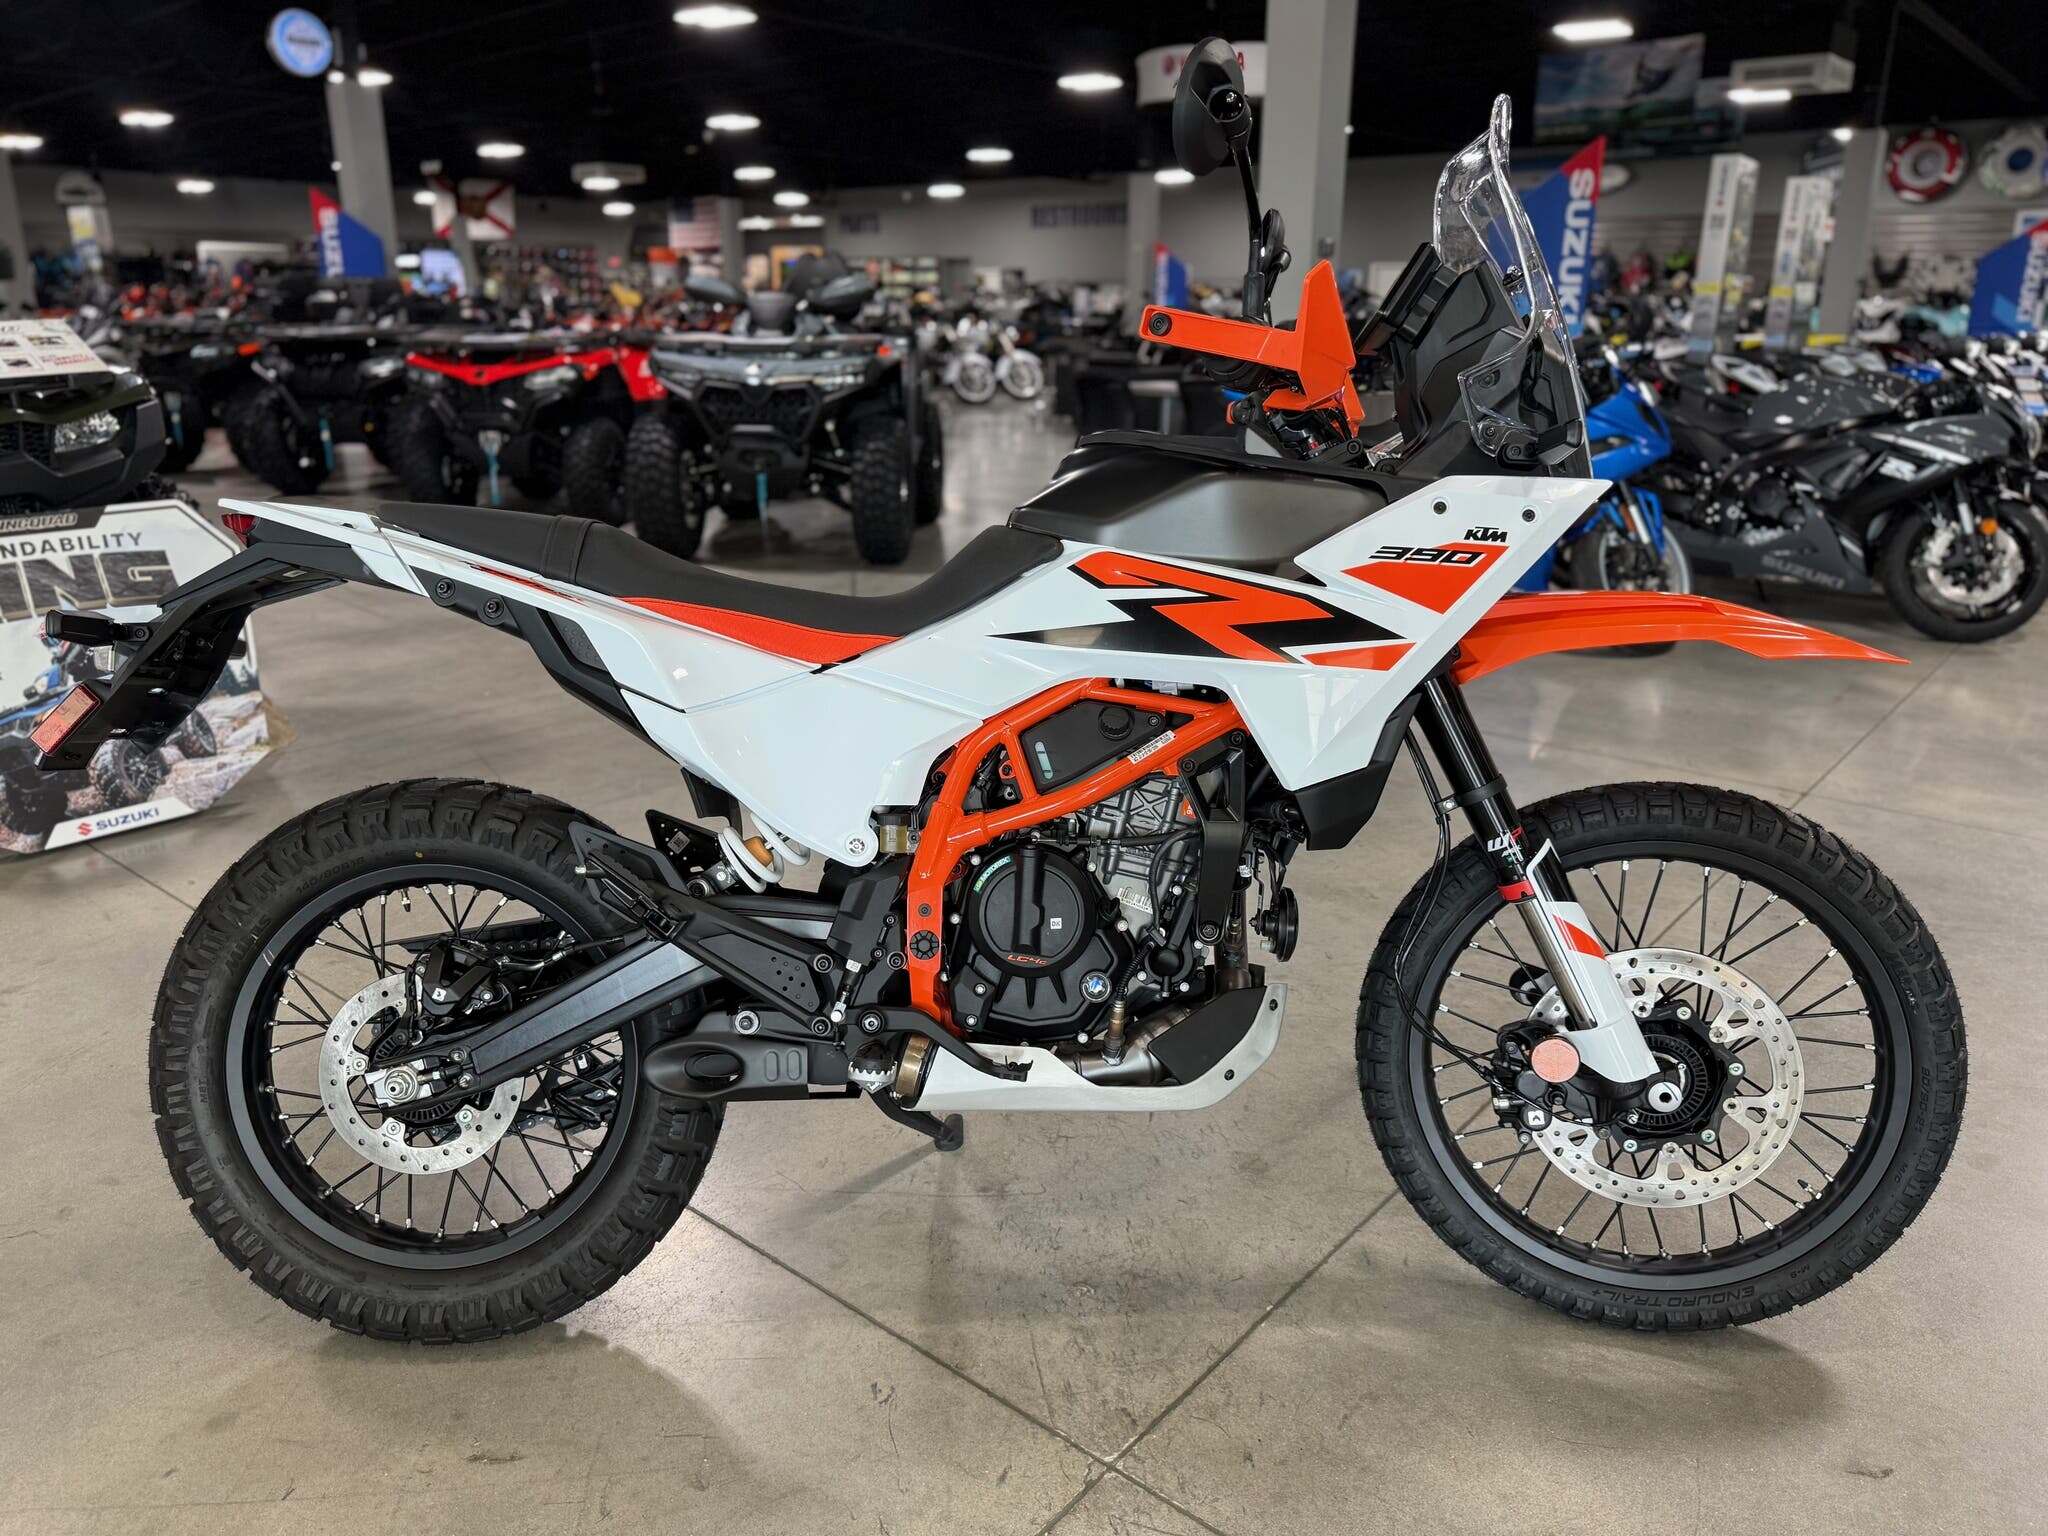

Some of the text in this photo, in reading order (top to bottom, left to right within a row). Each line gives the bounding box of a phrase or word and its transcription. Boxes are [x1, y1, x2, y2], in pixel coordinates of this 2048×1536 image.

[1559, 168, 1595, 324] SUZUKI
[1464, 526, 1508, 543] KTM
[1368, 545, 1486, 566] 390
[96, 807, 160, 831] SUZUKI
[1667, 1285, 1756, 1308] ENDURO
